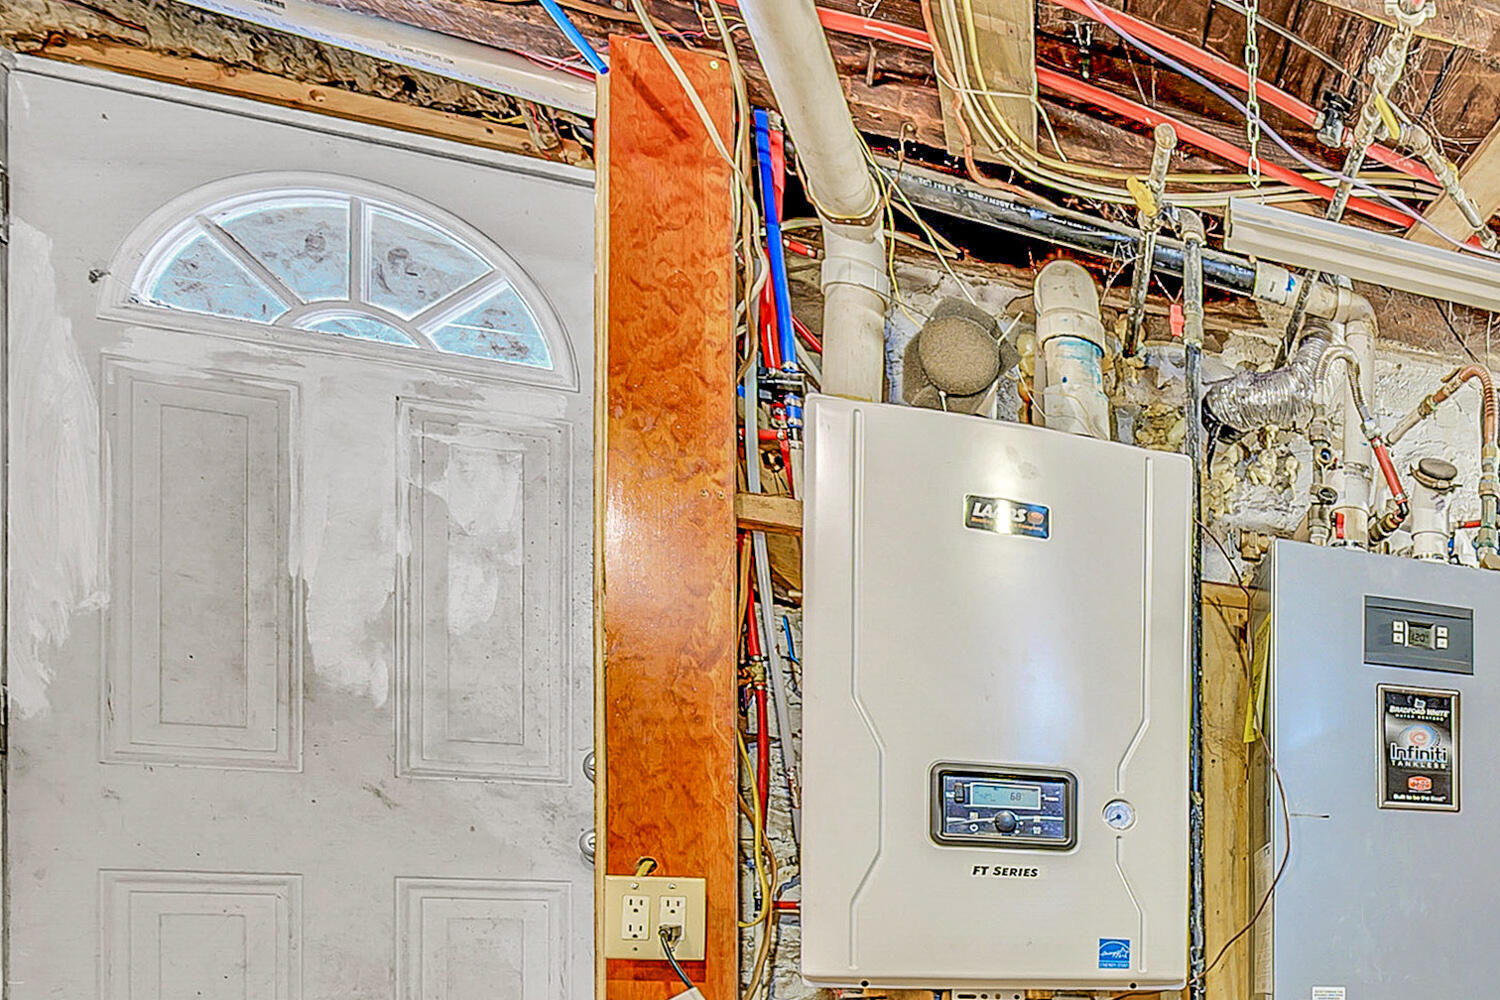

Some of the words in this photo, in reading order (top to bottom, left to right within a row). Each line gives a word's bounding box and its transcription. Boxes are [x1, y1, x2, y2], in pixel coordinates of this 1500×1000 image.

[972, 502, 1028, 522] LAS
[1390, 742, 1447, 762] Infiniti
[1391, 760, 1446, 769] TANKLESS
[972, 866, 989, 876] FT
[993, 867, 1039, 877] SERIES
